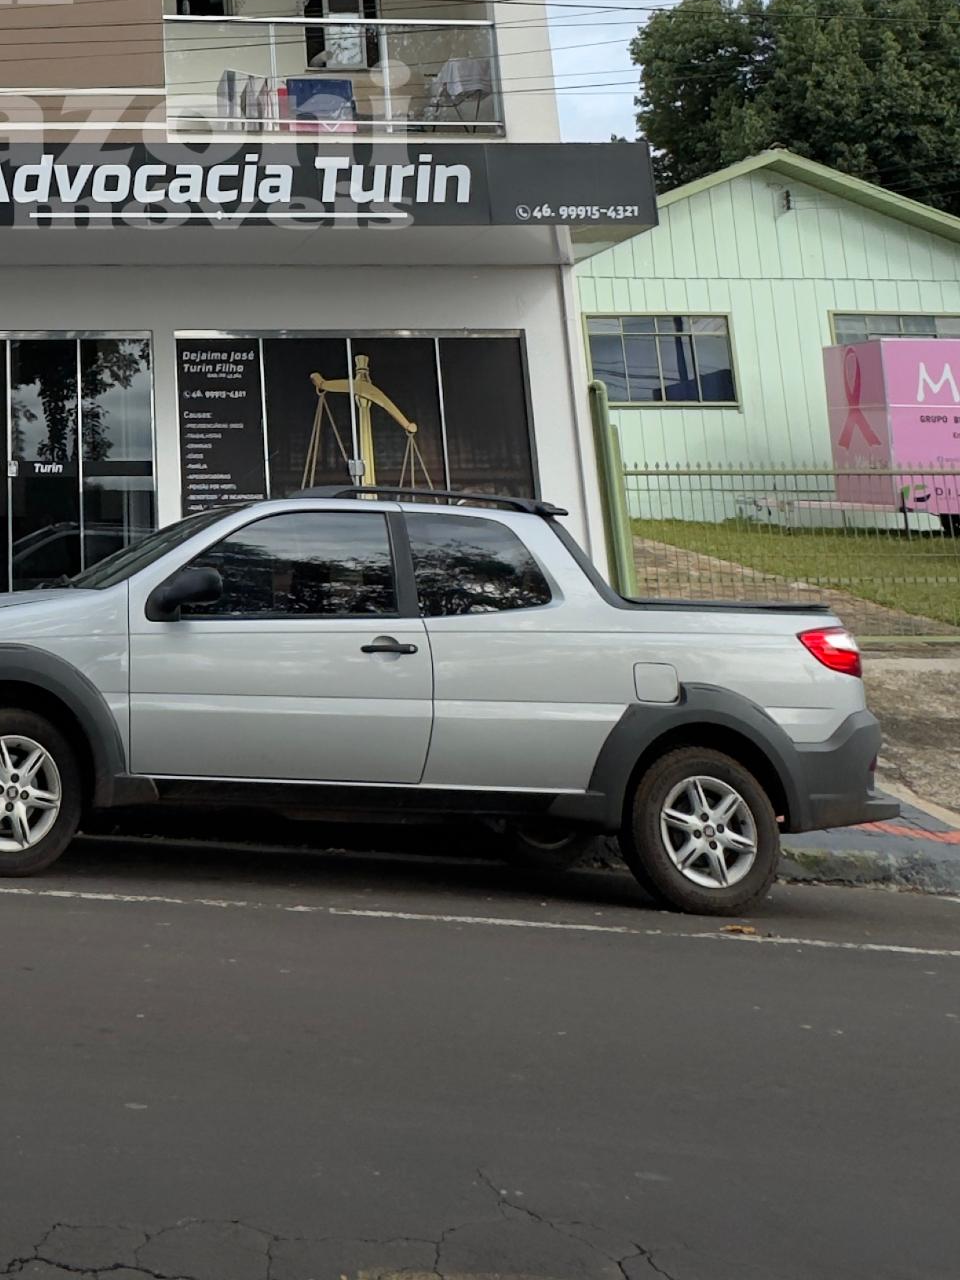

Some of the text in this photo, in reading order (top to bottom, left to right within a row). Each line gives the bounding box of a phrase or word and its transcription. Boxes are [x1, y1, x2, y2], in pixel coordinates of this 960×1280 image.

[315, 154, 471, 203] Turin
[533, 203, 638, 219] 46. 99915-4321
[229, 350, 255, 362] José
[183, 363, 244, 373] Turin Filho
[34, 462, 63, 473] Turin
